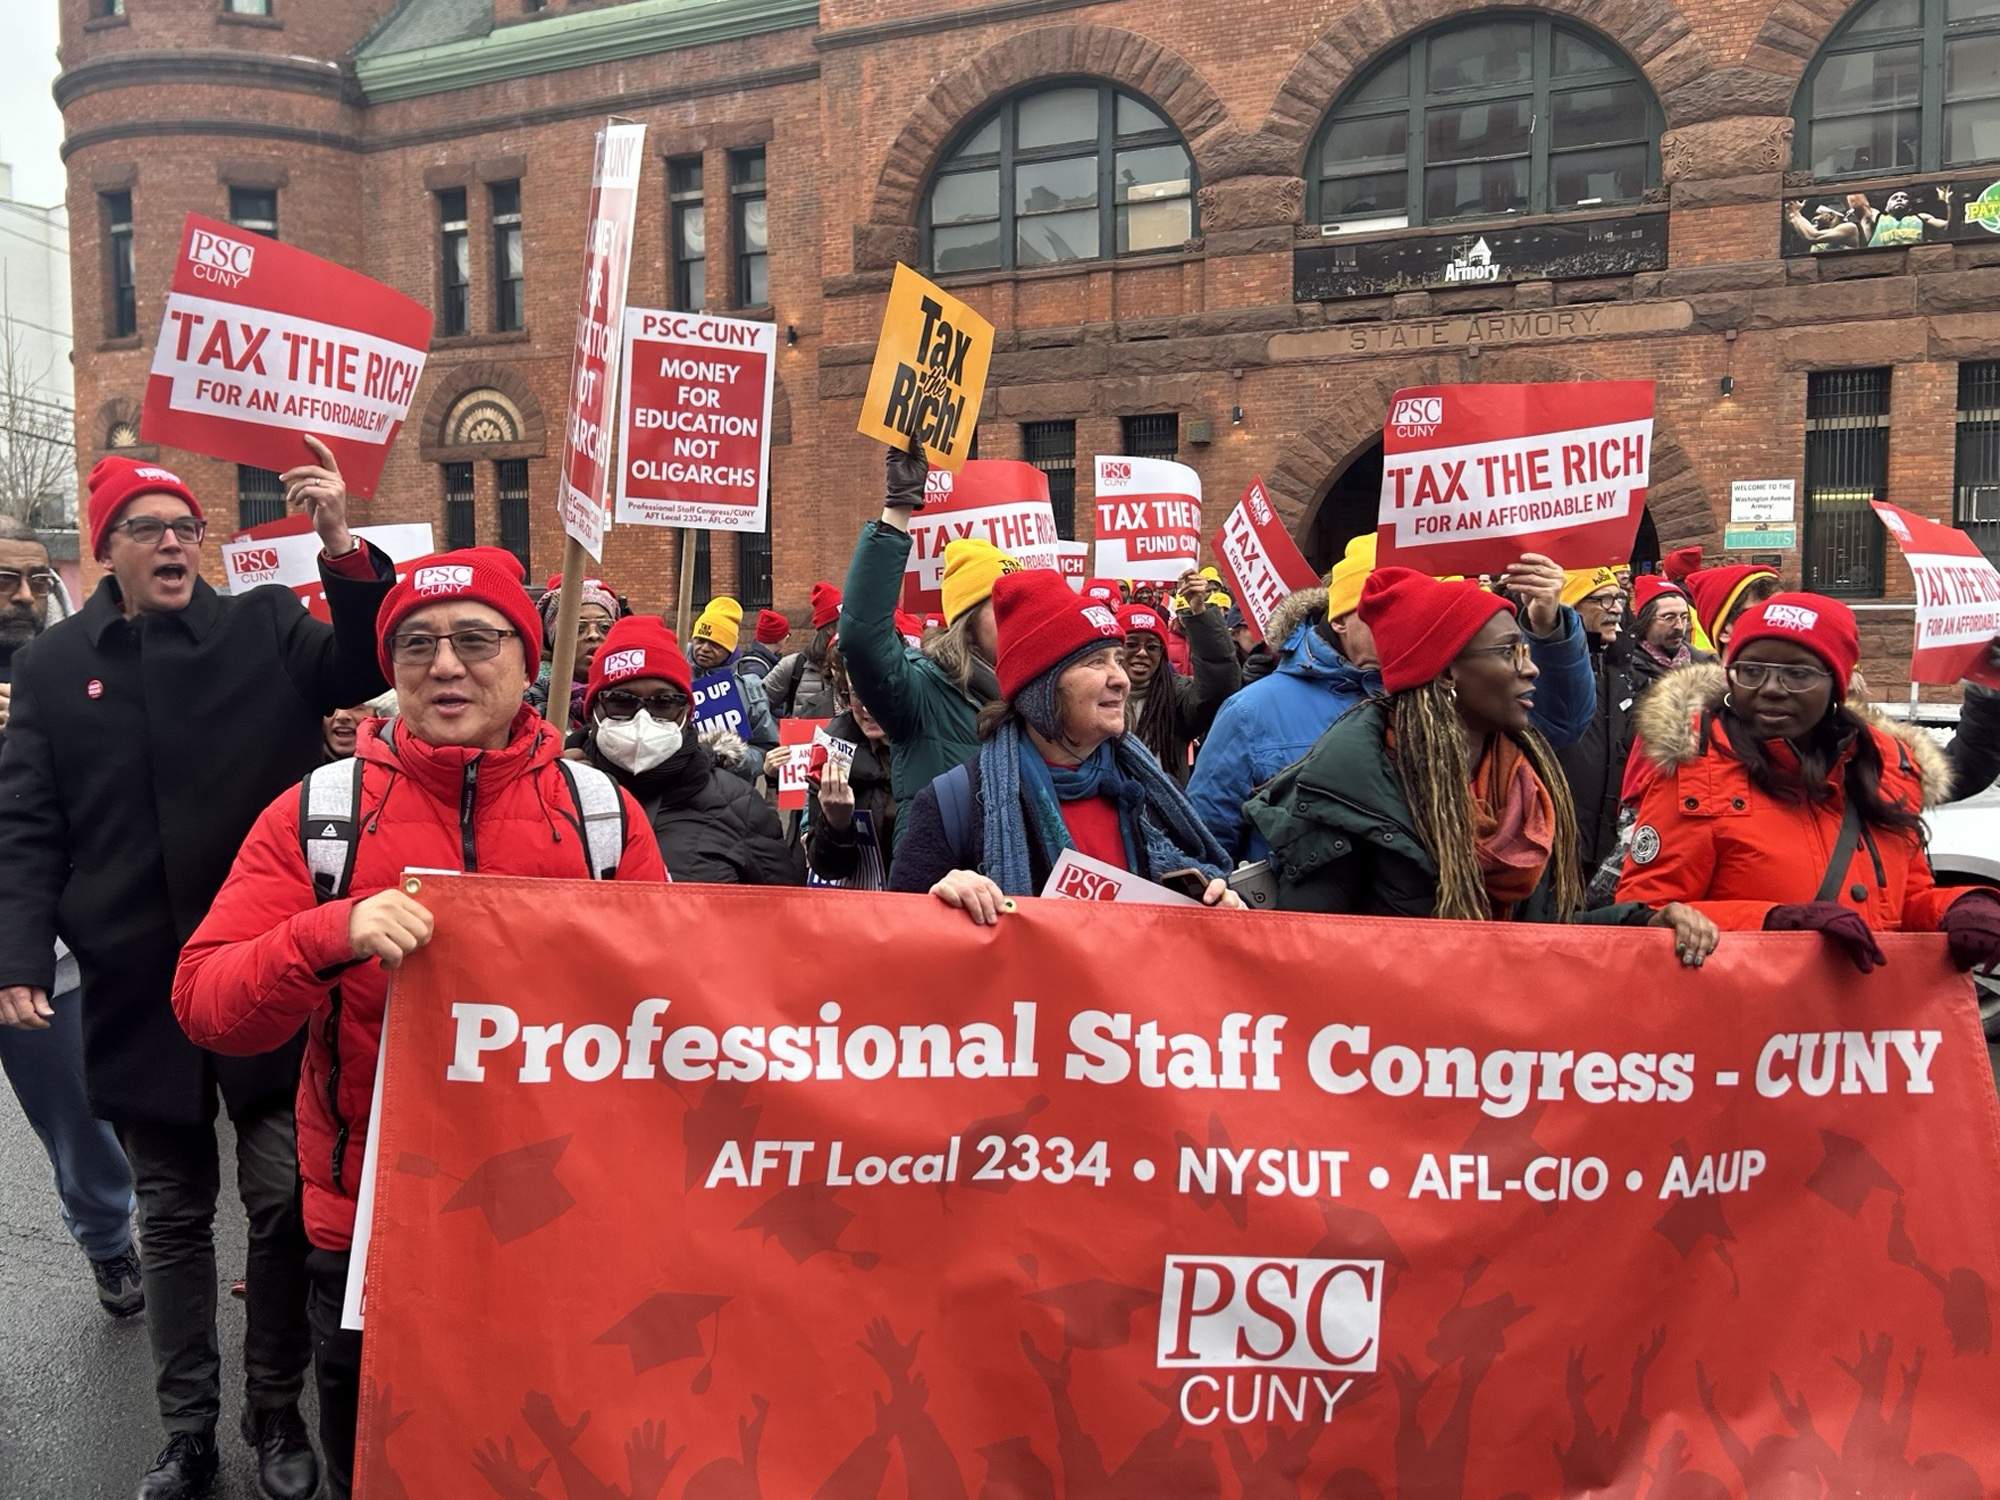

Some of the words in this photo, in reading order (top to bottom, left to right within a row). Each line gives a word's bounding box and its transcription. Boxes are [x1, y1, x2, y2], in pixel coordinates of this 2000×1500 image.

[1969, 203, 2000, 220] PAT
[191, 231, 252, 274] PSC
[193, 264, 243, 288] CUNY
[1445, 264, 1500, 282] Armory
[643, 315, 760, 346] PSC-CUNY
[916, 295, 972, 386] Tax
[1350, 324, 1449, 350] STATE
[171, 310, 270, 376] TAX
[282, 331, 359, 393] THE
[364, 352, 419, 407] RICH
[660, 358, 740, 383] MONEY
[923, 368, 947, 397] the
[196, 379, 242, 407] FOR
[246, 388, 279, 413] AN
[283, 395, 375, 432] AFFORDABLE
[375, 412, 388, 432] NY
[678, 386, 721, 408] FOR
[883, 361, 965, 455] Rich!
[635, 408, 757, 437] EDUCATION
[1394, 398, 1441, 424] PSC
[1397, 425, 1437, 438] CUNY
[674, 437, 720, 459] NOT
[631, 460, 755, 487] OLIGARCHS
[926, 472, 952, 492] SC
[1102, 463, 1130, 479] PSC
[1104, 479, 1128, 487] CUNY
[1387, 460, 1468, 508] TAX
[1477, 449, 1552, 498] THE
[1562, 434, 1644, 486] RICH
[628, 502, 675, 513] Professional
[677, 505, 696, 513] Staff
[924, 493, 949, 503] UNY
[1251, 486, 1272, 525] PSC
[645, 512, 659, 520] AFT
[661, 513, 680, 521] Local
[683, 515, 702, 523] 2334
[708, 516, 739, 524] AFL-CIO
[1098, 502, 1148, 531] TAX
[1152, 501, 1192, 528] THE
[1415, 517, 1451, 535] FOR
[1456, 511, 1482, 532] AN
[1487, 494, 1593, 528] AFFORDABLE
[1597, 490, 1617, 511] NY
[983, 513, 1033, 548] THE
[1730, 533, 1792, 547] TICKETS
[1136, 536, 1177, 554] FUND
[233, 549, 278, 573] PSC
[1060, 559, 1084, 573] ICH
[1229, 549, 1243, 576] FOR
[1240, 574, 1251, 592] AN
[1230, 509, 1261, 573] TAX
[1256, 565, 1285, 612] TH
[241, 570, 277, 584] CUNY
[419, 568, 470, 585] PSC
[1914, 567, 1951, 607] TAX
[1945, 567, 1981, 605] THE
[421, 584, 464, 597] CUNY
[1087, 607, 1116, 625] PS
[1767, 619, 1804, 632] CUNY
[1769, 607, 1815, 625] PSC
[1926, 618, 1943, 637] FOR
[1943, 616, 1954, 635] AN
[1955, 613, 2000, 635] AFFORDABLE
[606, 651, 643, 672] PSC
[609, 667, 640, 681] CUNY
[707, 681, 731, 700] UP
[1057, 865, 1121, 901] PSC
[446, 998, 1039, 1083] Professional
[1065, 1009, 1289, 1091] Staff
[1307, 1023, 1695, 1119] Congress
[1716, 1071, 1740, 1086] -
[1755, 1030, 1943, 1098] CUNY
[704, 1140, 814, 1188] AFT
[825, 1136, 960, 1187] Local
[970, 1134, 1111, 1187] 2334
[1179, 1146, 1349, 1197] NYSUT
[1408, 1153, 1609, 1201] AFL-CIO
[1658, 1150, 1766, 1200] AAUP
[1164, 1261, 1376, 1366] PSC
[1180, 1373, 1354, 1425] CUNY
